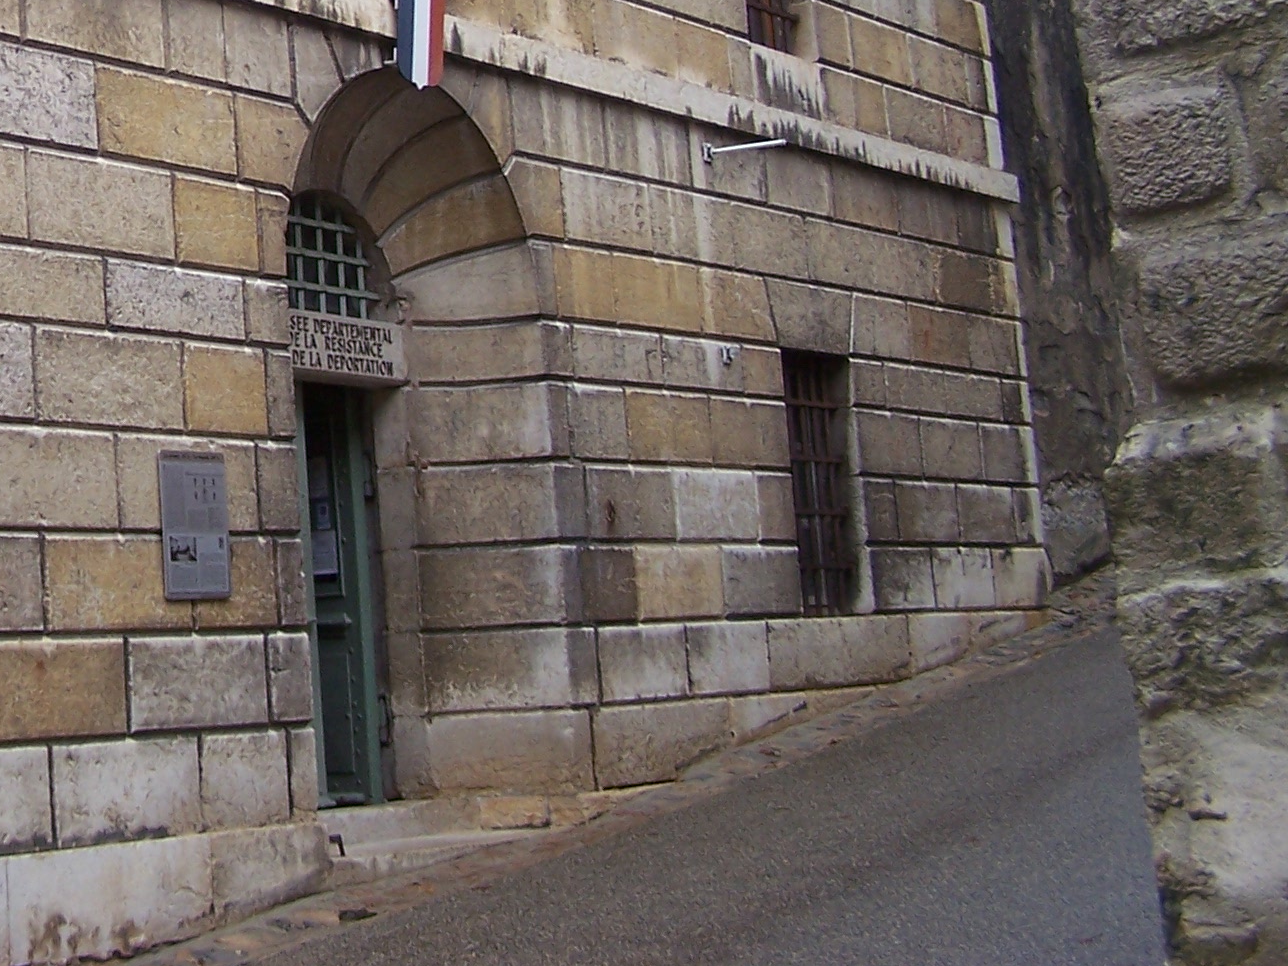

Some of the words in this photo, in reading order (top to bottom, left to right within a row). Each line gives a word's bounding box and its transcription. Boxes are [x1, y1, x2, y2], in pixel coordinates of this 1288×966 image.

[304, 333, 317, 350] LA
[324, 335, 383, 359] RESISTANCE
[313, 318, 392, 354] DEPARTEMENTAL
[292, 349, 306, 365] DE
[309, 351, 322, 368] LA
[327, 354, 394, 376] DEPORTATION
